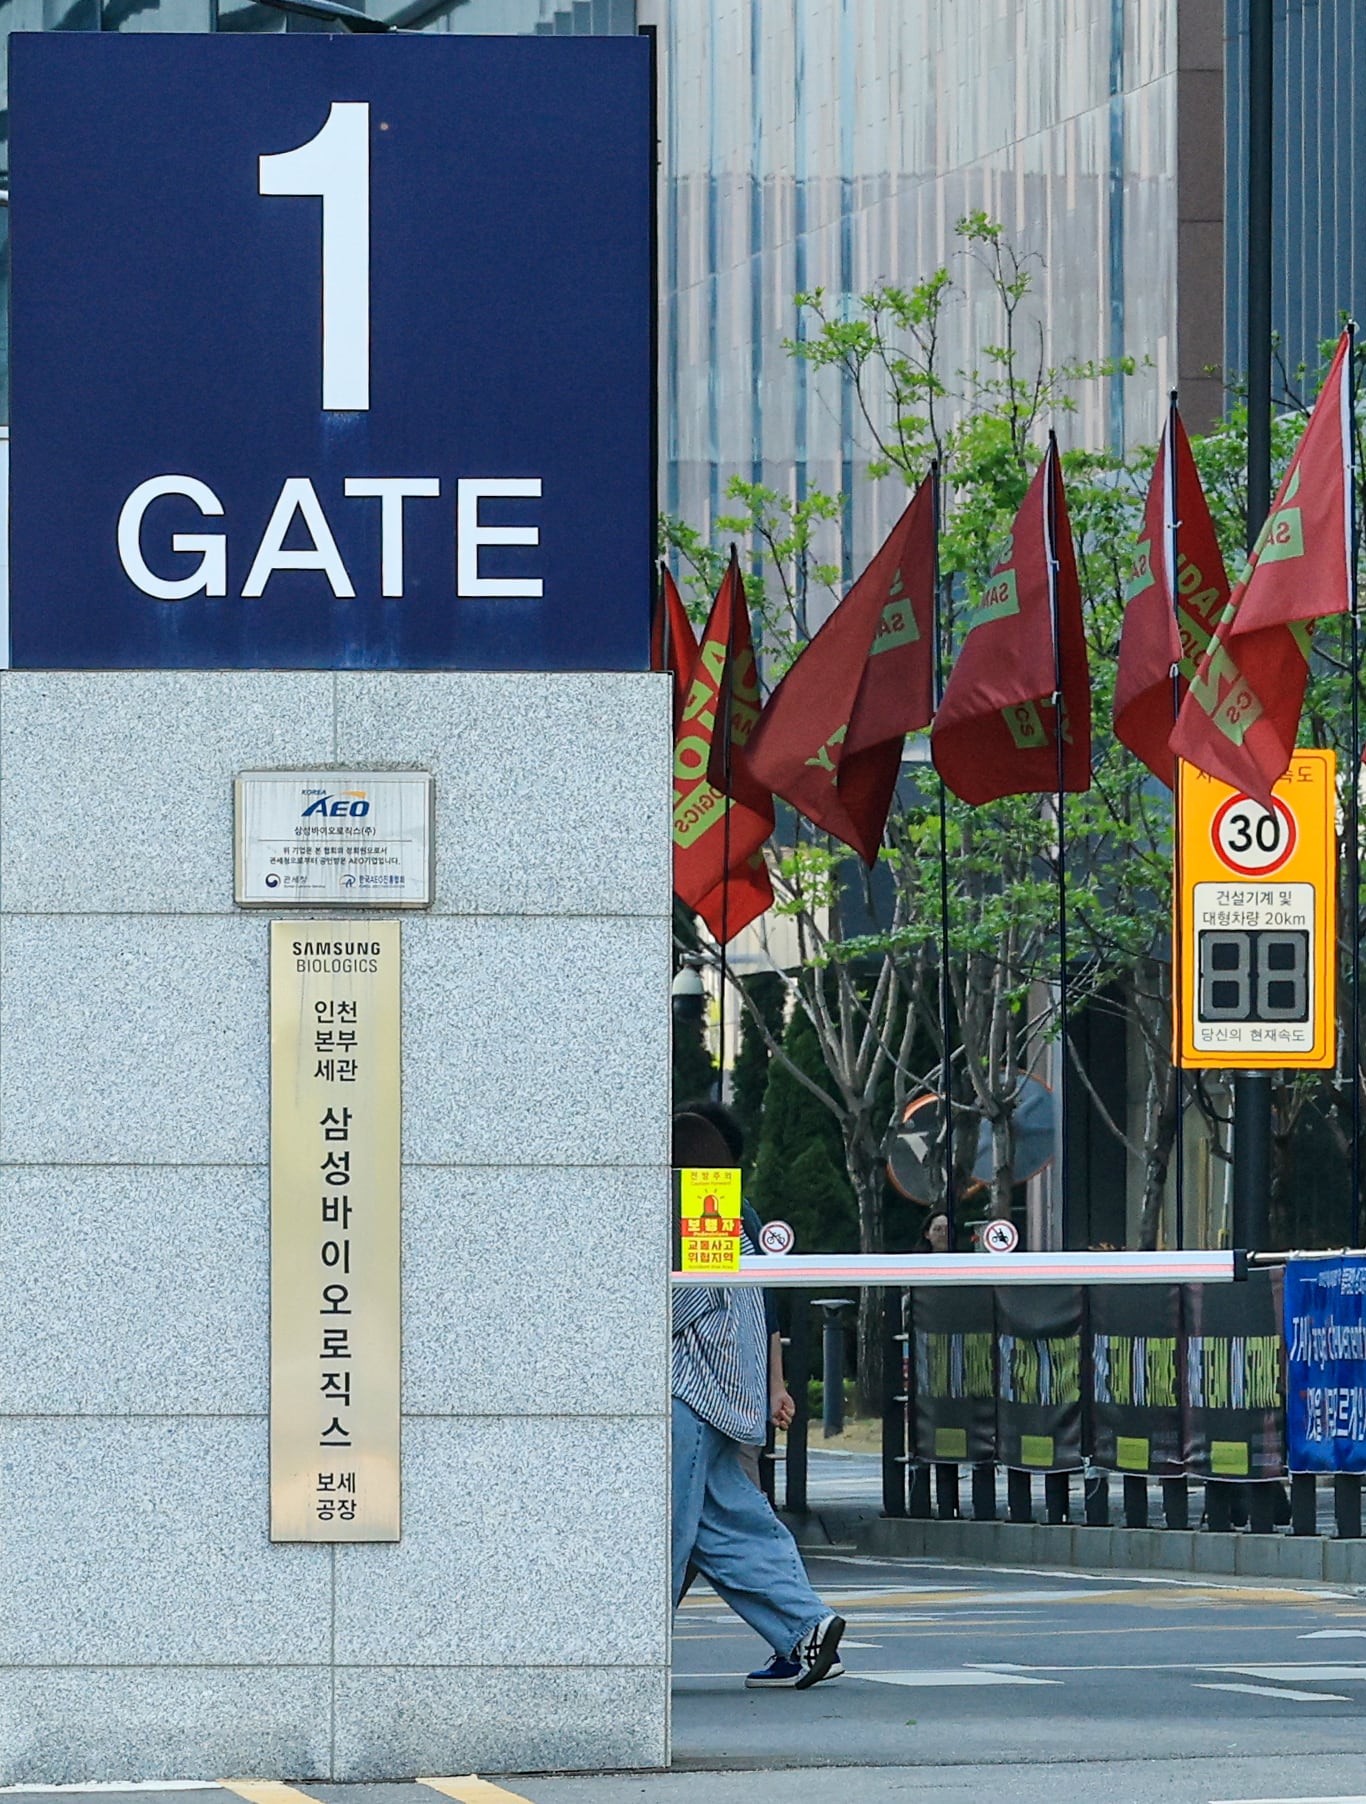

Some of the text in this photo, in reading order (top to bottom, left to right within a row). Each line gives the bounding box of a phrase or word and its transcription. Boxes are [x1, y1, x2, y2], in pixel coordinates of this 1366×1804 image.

[258, 101, 370, 410] 1
[117, 474, 544, 599] GATE
[301, 794, 370, 817] AEO
[1228, 814, 1280, 852] 30
[1216, 891, 1292, 906] 건설기계 및
[1203, 911, 1306, 927] 대형차량 20km
[292, 942, 381, 956] SAMSUNG
[296, 959, 378, 973] BIOLOGICS
[314, 1000, 358, 1024] 인천
[314, 1030, 358, 1052] 본부
[1201, 1028, 1305, 1042] 당신의 현재속도
[314, 1059, 358, 1082] 세관
[319, 1106, 353, 1448] 삼성바이오로직스
[316, 1472, 357, 1494] 보세
[316, 1499, 357, 1521] 공장
